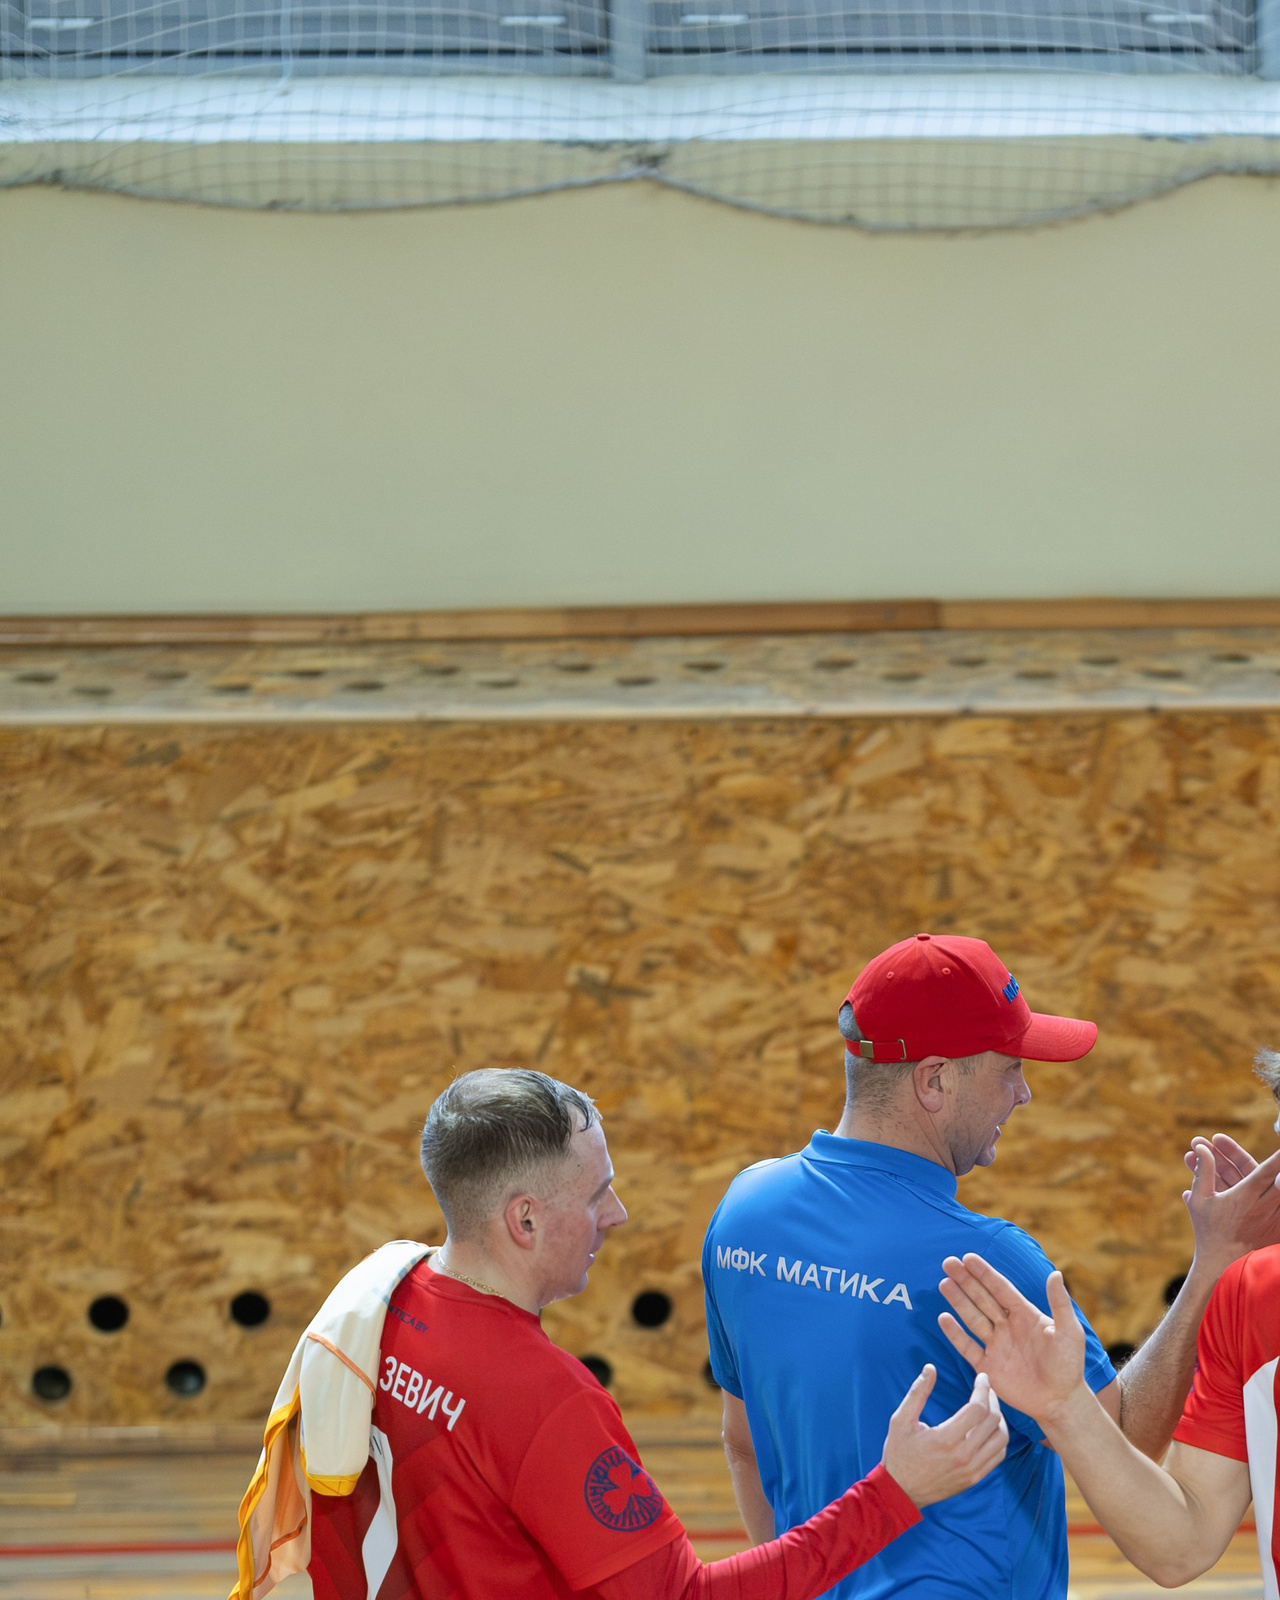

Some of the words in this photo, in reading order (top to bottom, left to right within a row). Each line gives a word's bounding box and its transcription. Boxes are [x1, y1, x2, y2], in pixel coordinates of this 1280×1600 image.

[717, 1245, 767, 1277] МФК
[776, 1256, 913, 1310] МАТИКА
[379, 1354, 466, 1432] ЗЕВИЧ
